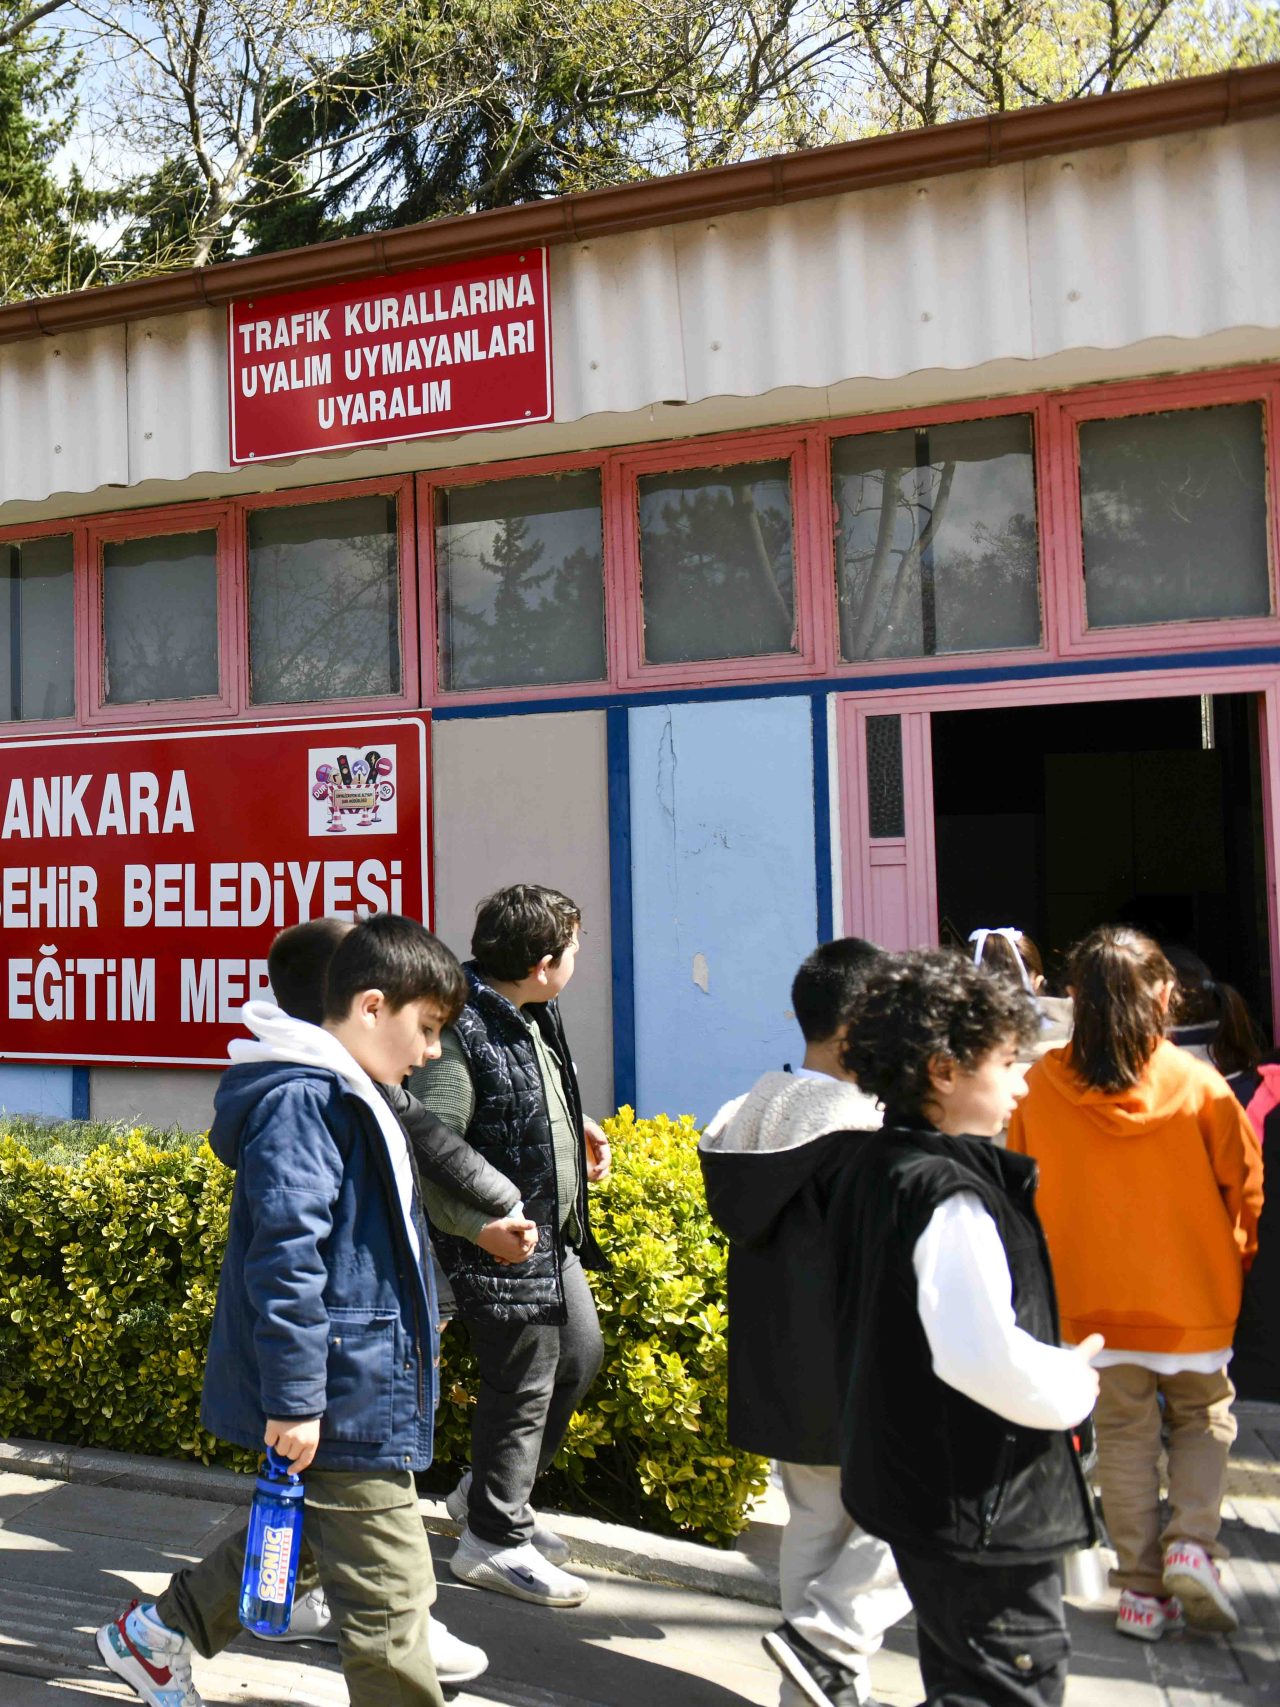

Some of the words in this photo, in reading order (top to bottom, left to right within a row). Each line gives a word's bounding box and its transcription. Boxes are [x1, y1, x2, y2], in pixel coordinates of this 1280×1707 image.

[345, 273, 536, 337] KURALLARINA
[241, 352, 332, 398] UYALIM
[344, 319, 536, 381] UYMAYANLARI
[317, 379, 452, 430] UYARALIM
[1, 769, 195, 839] ANKARA
[180, 958, 279, 1024] MER
[260, 1528, 282, 1599] SONIC
